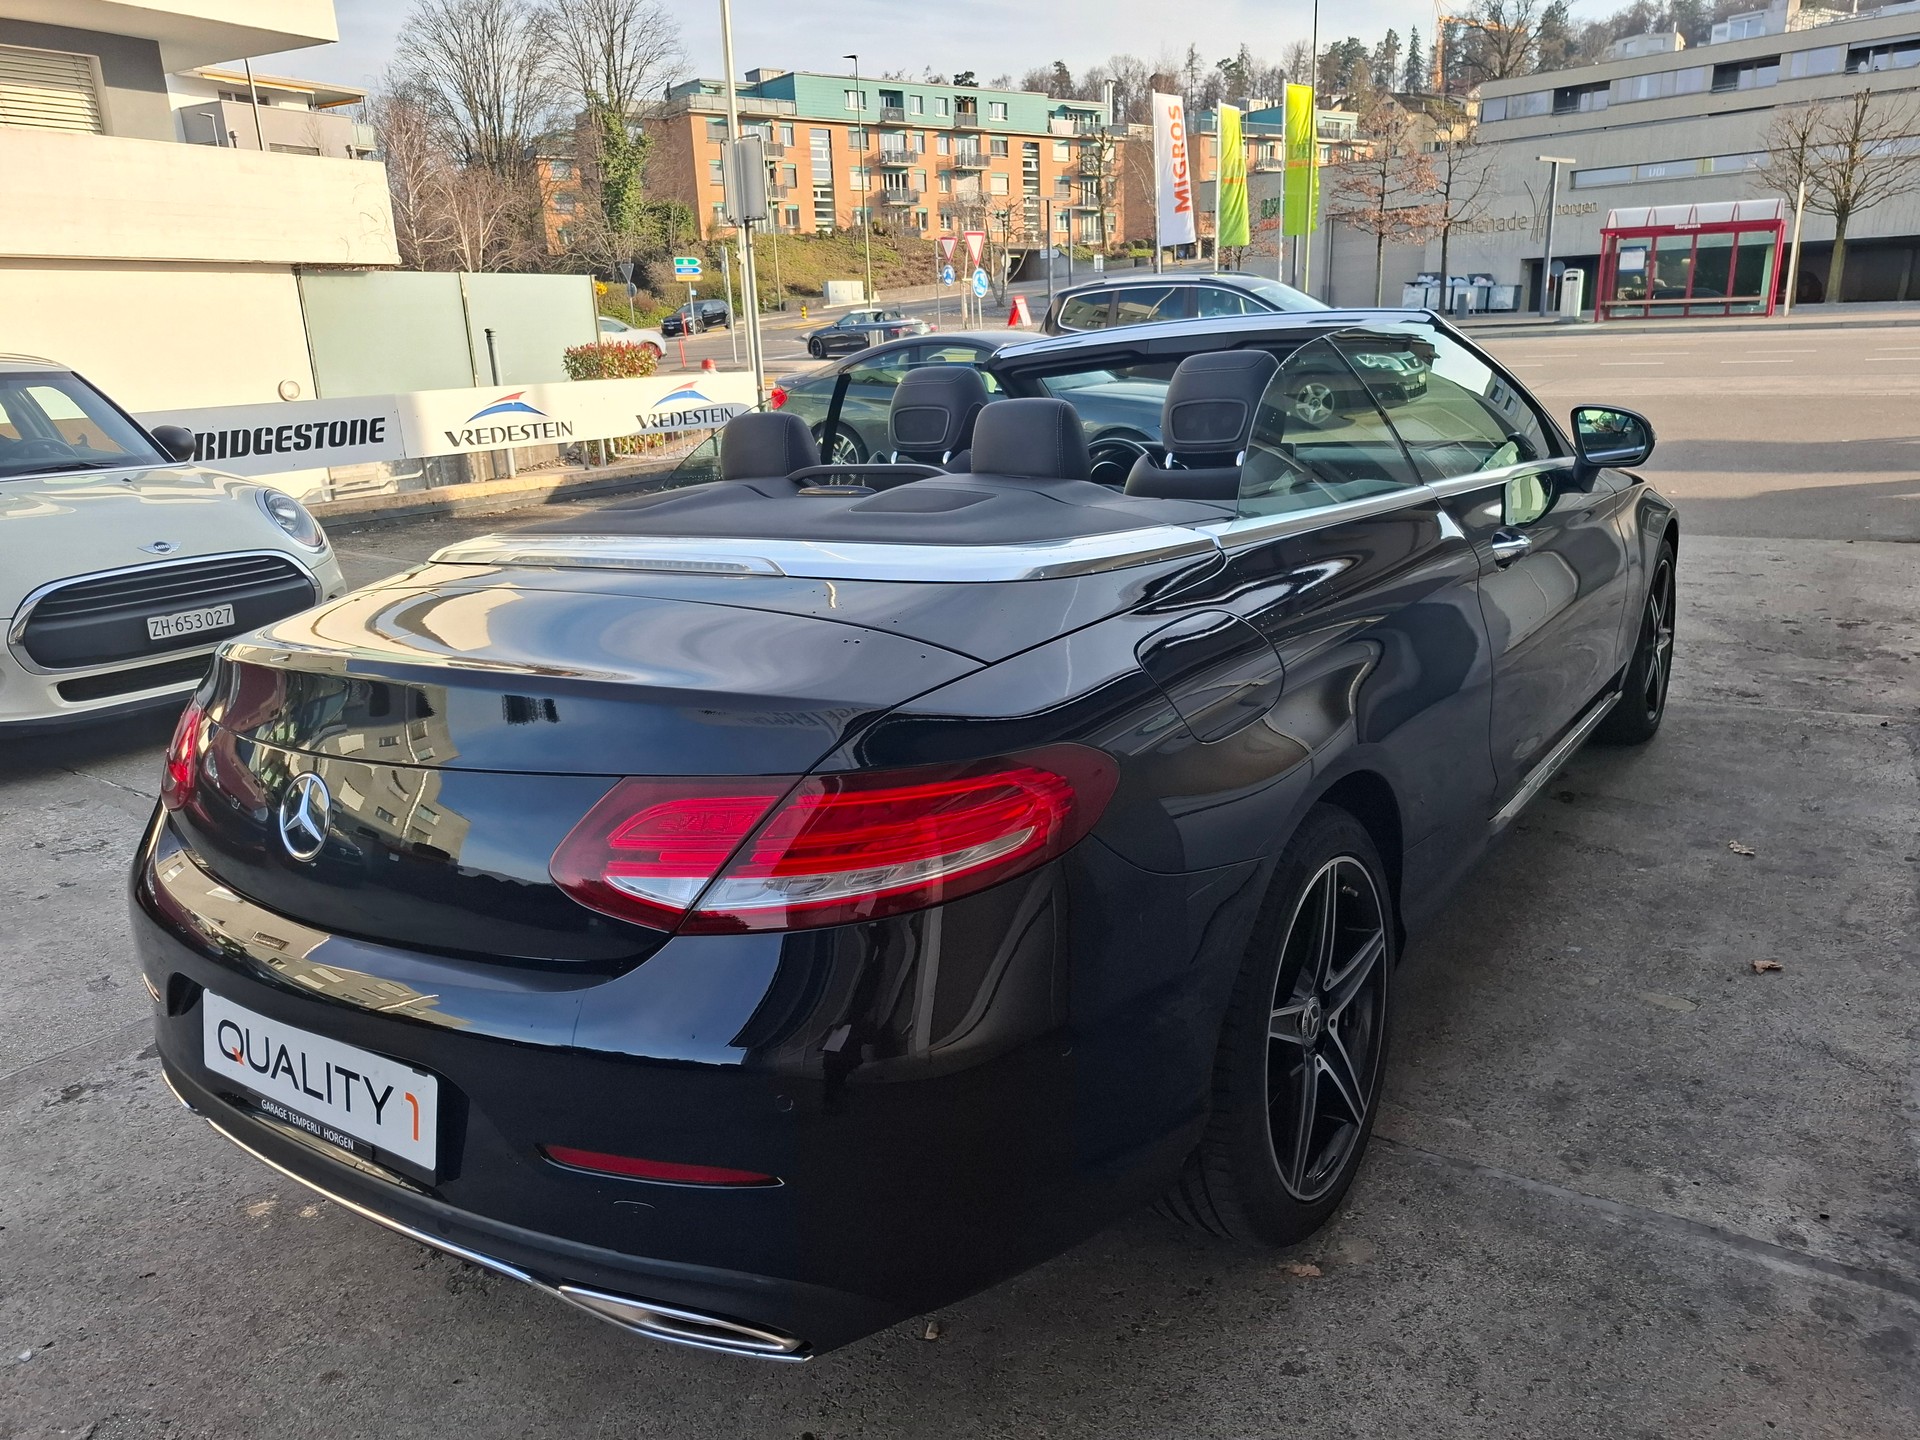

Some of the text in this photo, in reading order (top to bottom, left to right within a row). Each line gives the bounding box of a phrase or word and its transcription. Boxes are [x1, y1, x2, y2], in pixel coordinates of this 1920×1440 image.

[1168, 104, 1191, 214] MIGROS
[184, 417, 386, 462] RIDGESTONE
[444, 420, 573, 448] VREDESTEIN
[635, 407, 734, 430] VREDESTEIN
[217, 1019, 419, 1142] QUALITY 1
[261, 1099, 354, 1150] GARAGE TEMPERLI HORGEN
